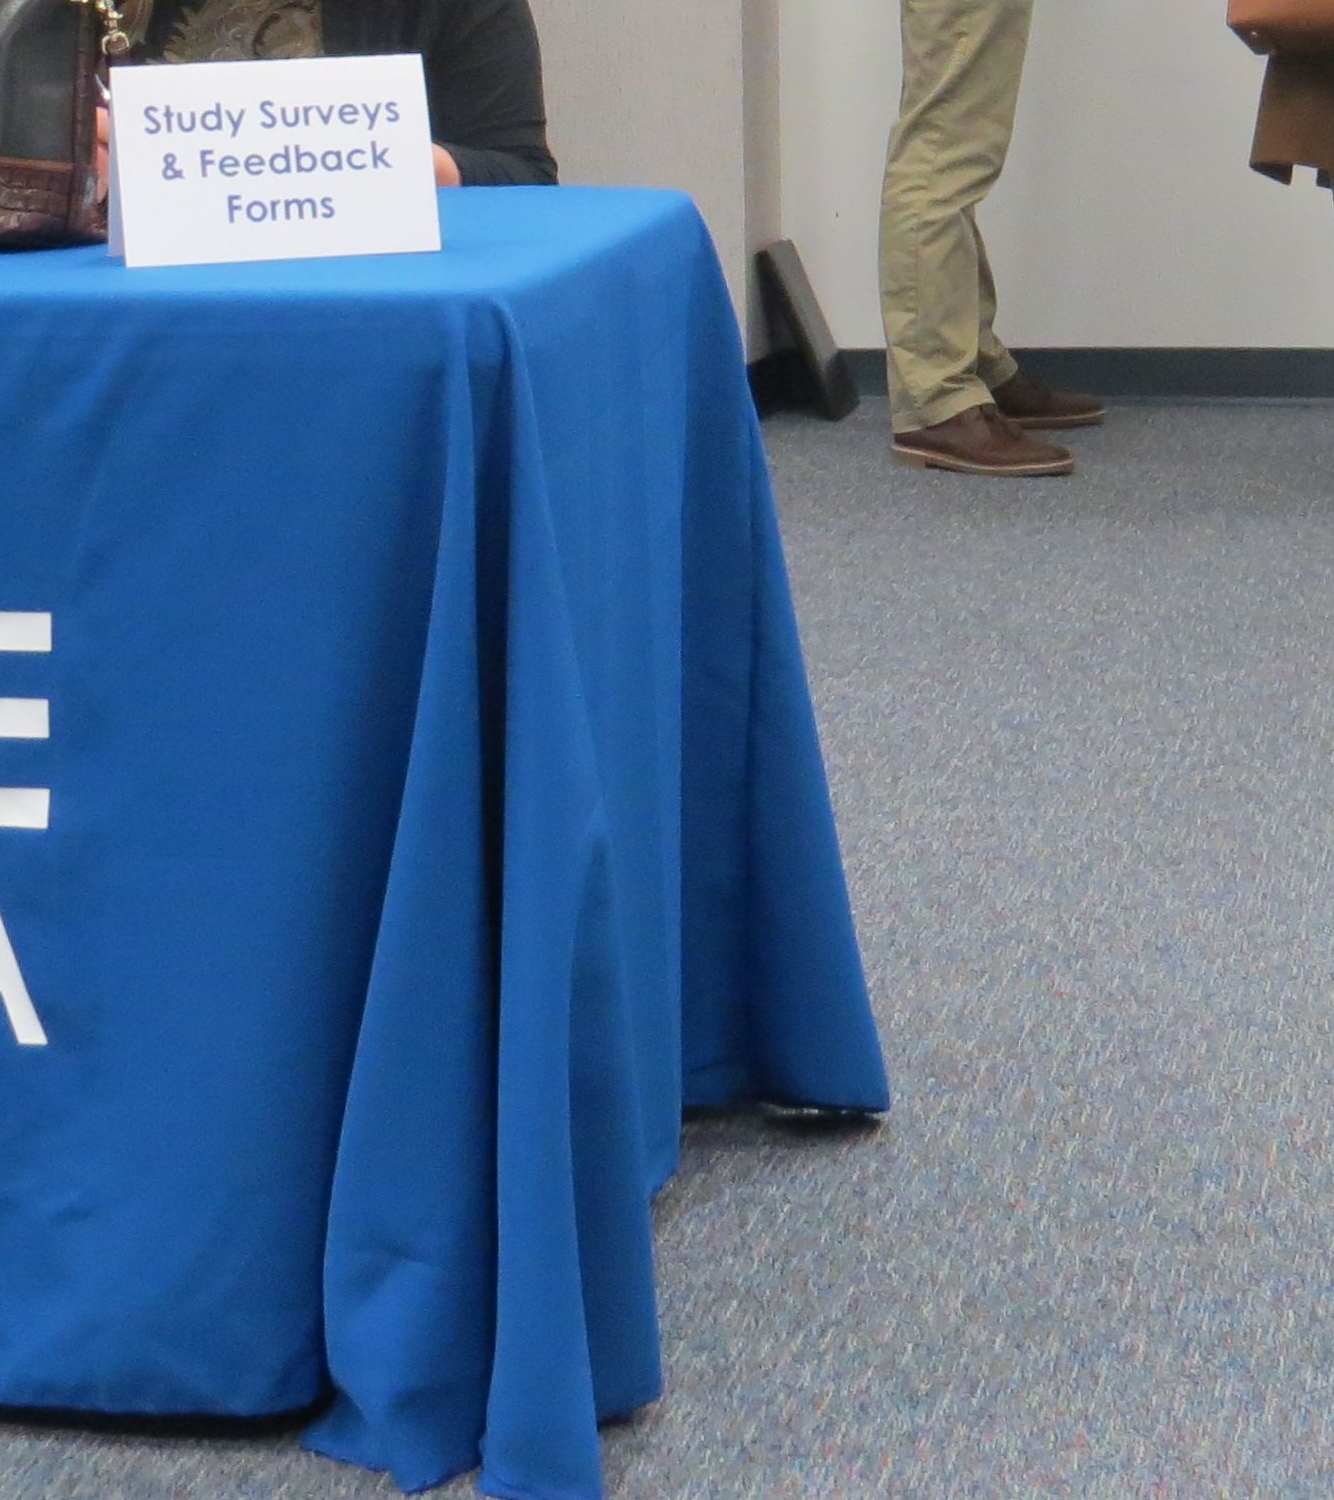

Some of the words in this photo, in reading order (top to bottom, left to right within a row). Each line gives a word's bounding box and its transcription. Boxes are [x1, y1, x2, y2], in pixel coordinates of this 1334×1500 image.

[143, 102, 246, 138] Study
[259, 100, 401, 131] Surveys
[161, 152, 185, 182] &
[199, 140, 393, 178] Feedback
[227, 195, 336, 224] Forms
